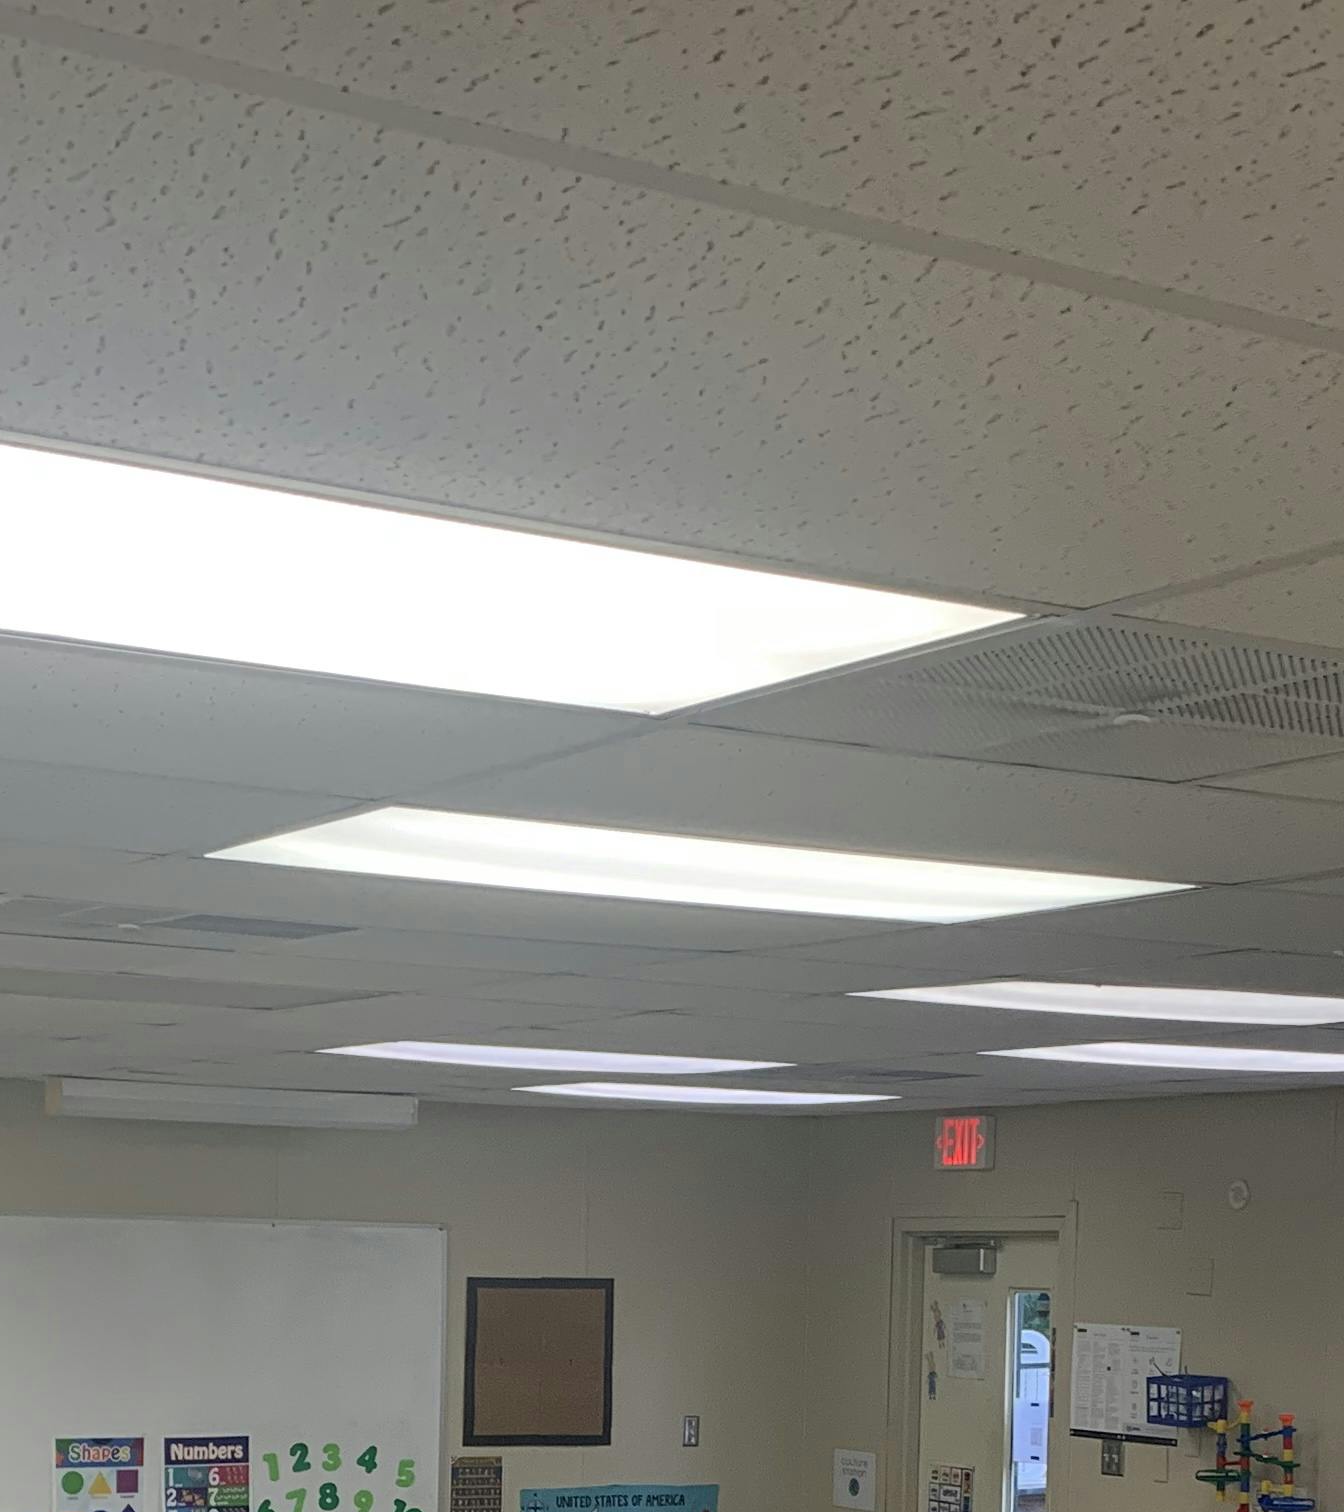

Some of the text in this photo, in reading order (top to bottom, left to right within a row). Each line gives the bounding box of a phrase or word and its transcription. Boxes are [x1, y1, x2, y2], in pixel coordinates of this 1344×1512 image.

[942, 1118, 981, 1166] EXIT
[68, 1443, 131, 1462] Shapes
[170, 1442, 244, 1461] Numbers
[208, 1467, 220, 1486] 6
[166, 1488, 177, 1507] 2
[207, 1487, 219, 1507] 7
[556, 1493, 685, 1508] UNITED STATES OF AMERICA
